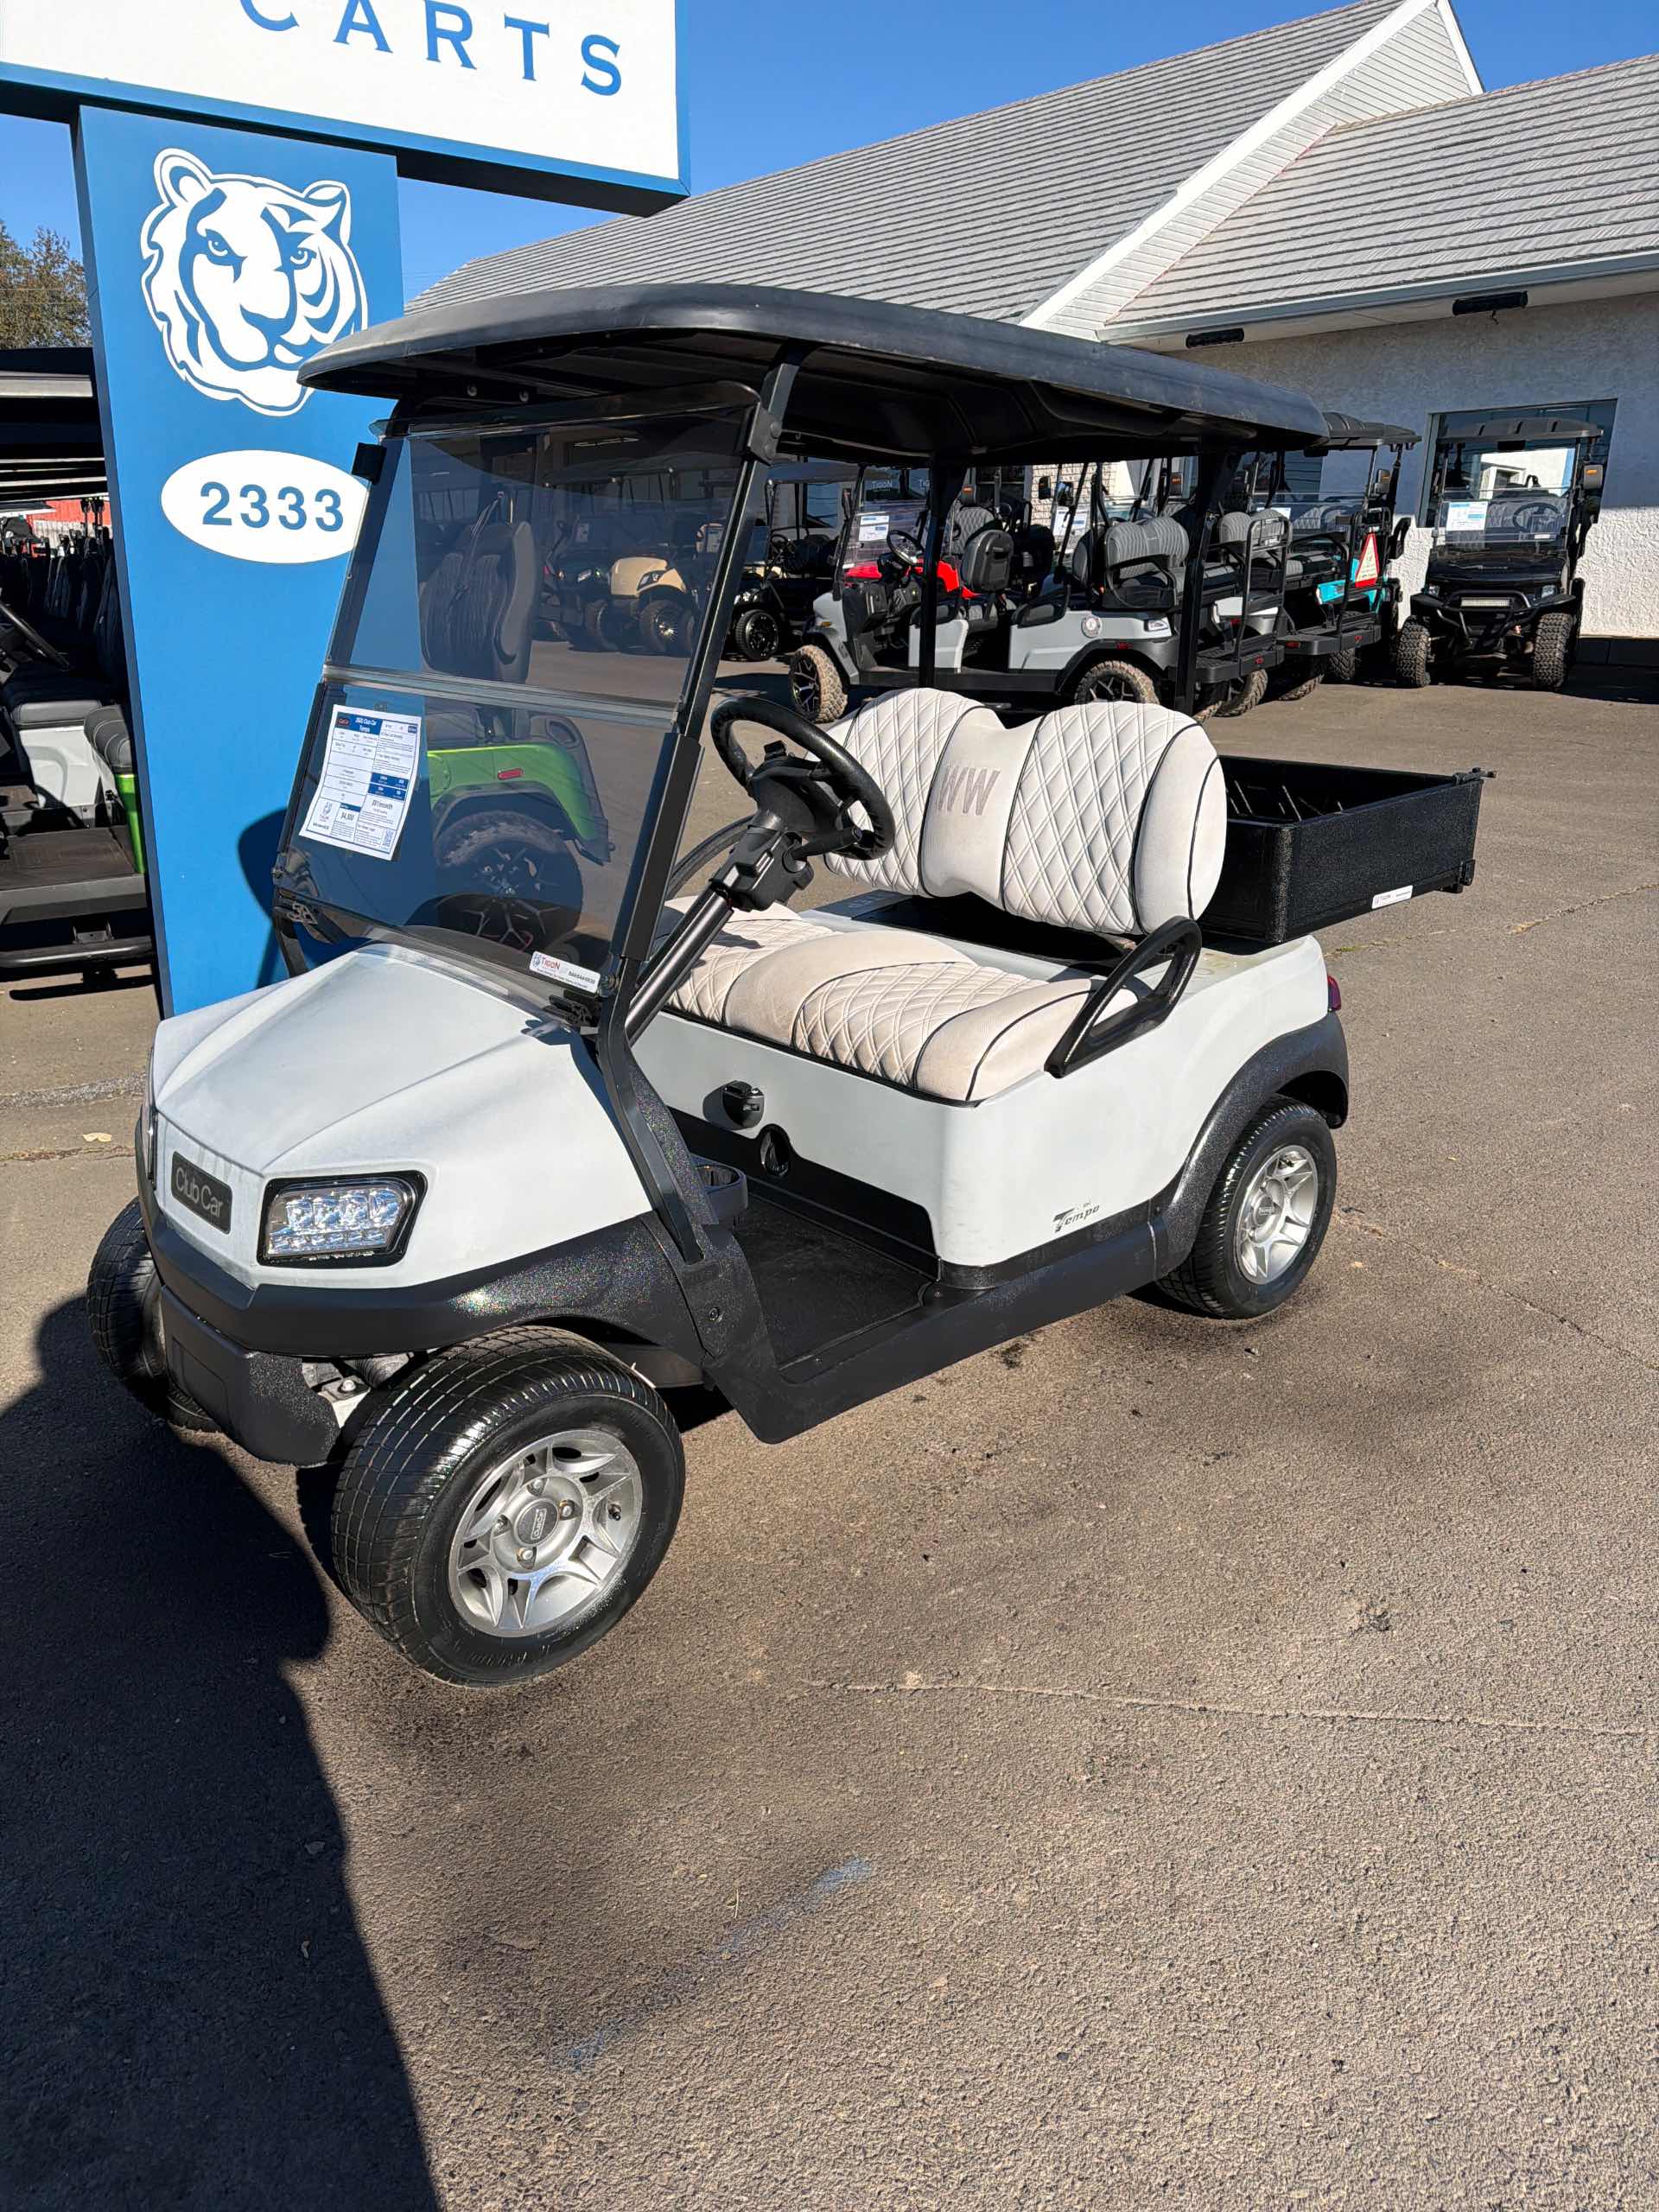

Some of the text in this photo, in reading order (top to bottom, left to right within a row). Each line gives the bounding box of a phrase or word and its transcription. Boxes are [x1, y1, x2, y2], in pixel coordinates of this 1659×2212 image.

[200, 482, 343, 531] 2333
[542, 957, 560, 970] TIGON
[1053, 1205, 1099, 1233] Tempo
